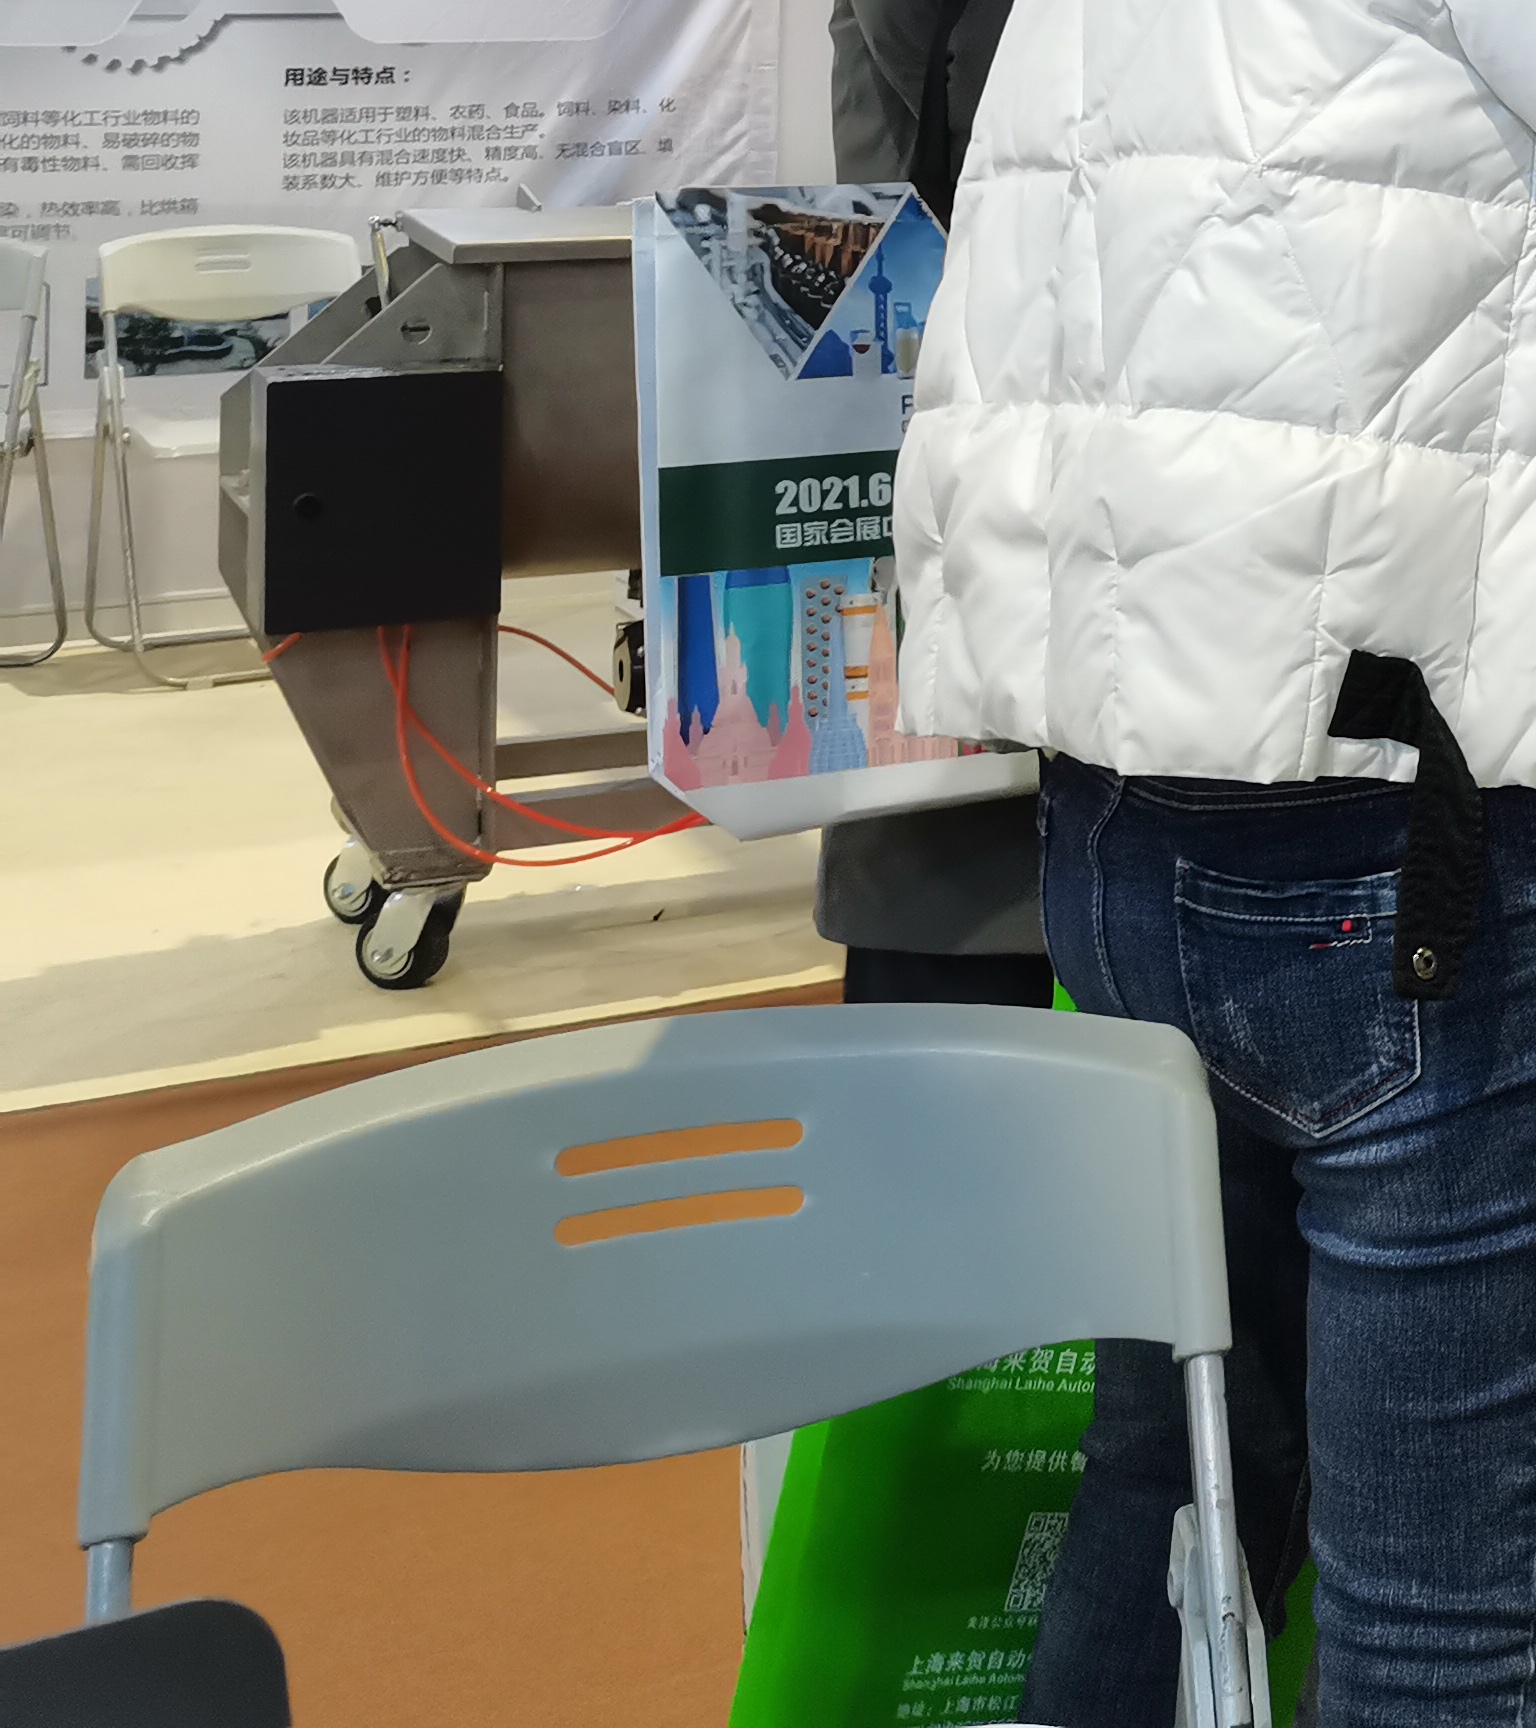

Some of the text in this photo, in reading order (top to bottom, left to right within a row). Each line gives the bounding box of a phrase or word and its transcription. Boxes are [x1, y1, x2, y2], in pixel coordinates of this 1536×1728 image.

[284, 67, 412, 87] 用途与特点：
[906, 1649, 1033, 1675] 上海来贺自动
